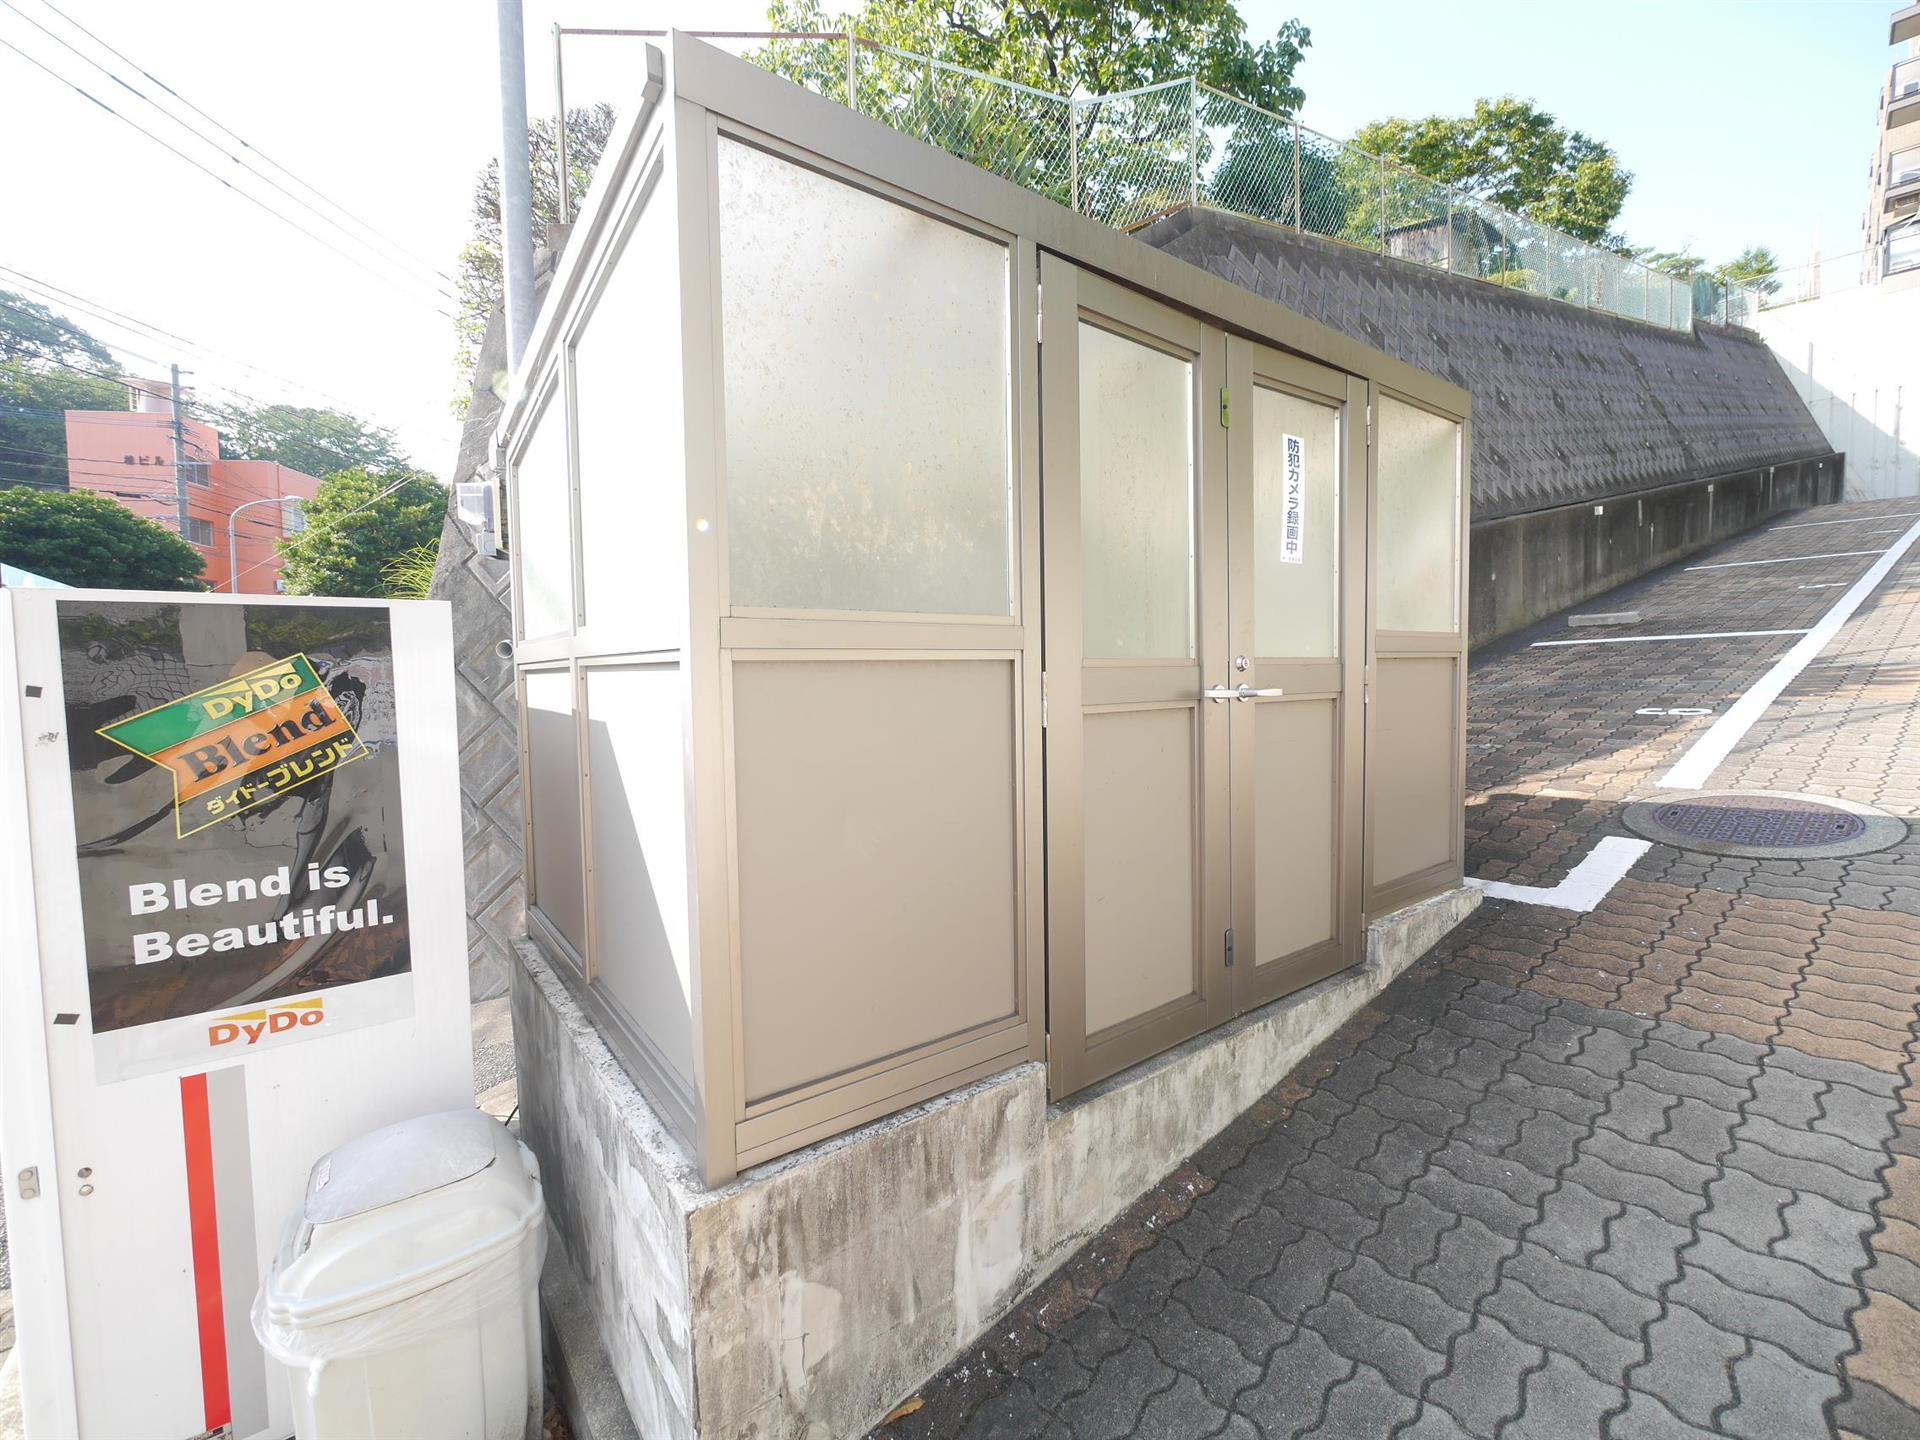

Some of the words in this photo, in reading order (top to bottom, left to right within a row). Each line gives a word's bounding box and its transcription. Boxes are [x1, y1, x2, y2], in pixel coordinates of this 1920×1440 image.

[1286, 438, 1300, 555] 防犯カメラ録画中
[202, 673, 303, 720] DyDo
[177, 698, 336, 783] Blend
[206, 737, 353, 815] ダイドーブレンド
[129, 866, 291, 916] Blend
[308, 862, 351, 892] is
[133, 898, 394, 966] Beautiful.
[208, 1009, 325, 1047] DyDo
